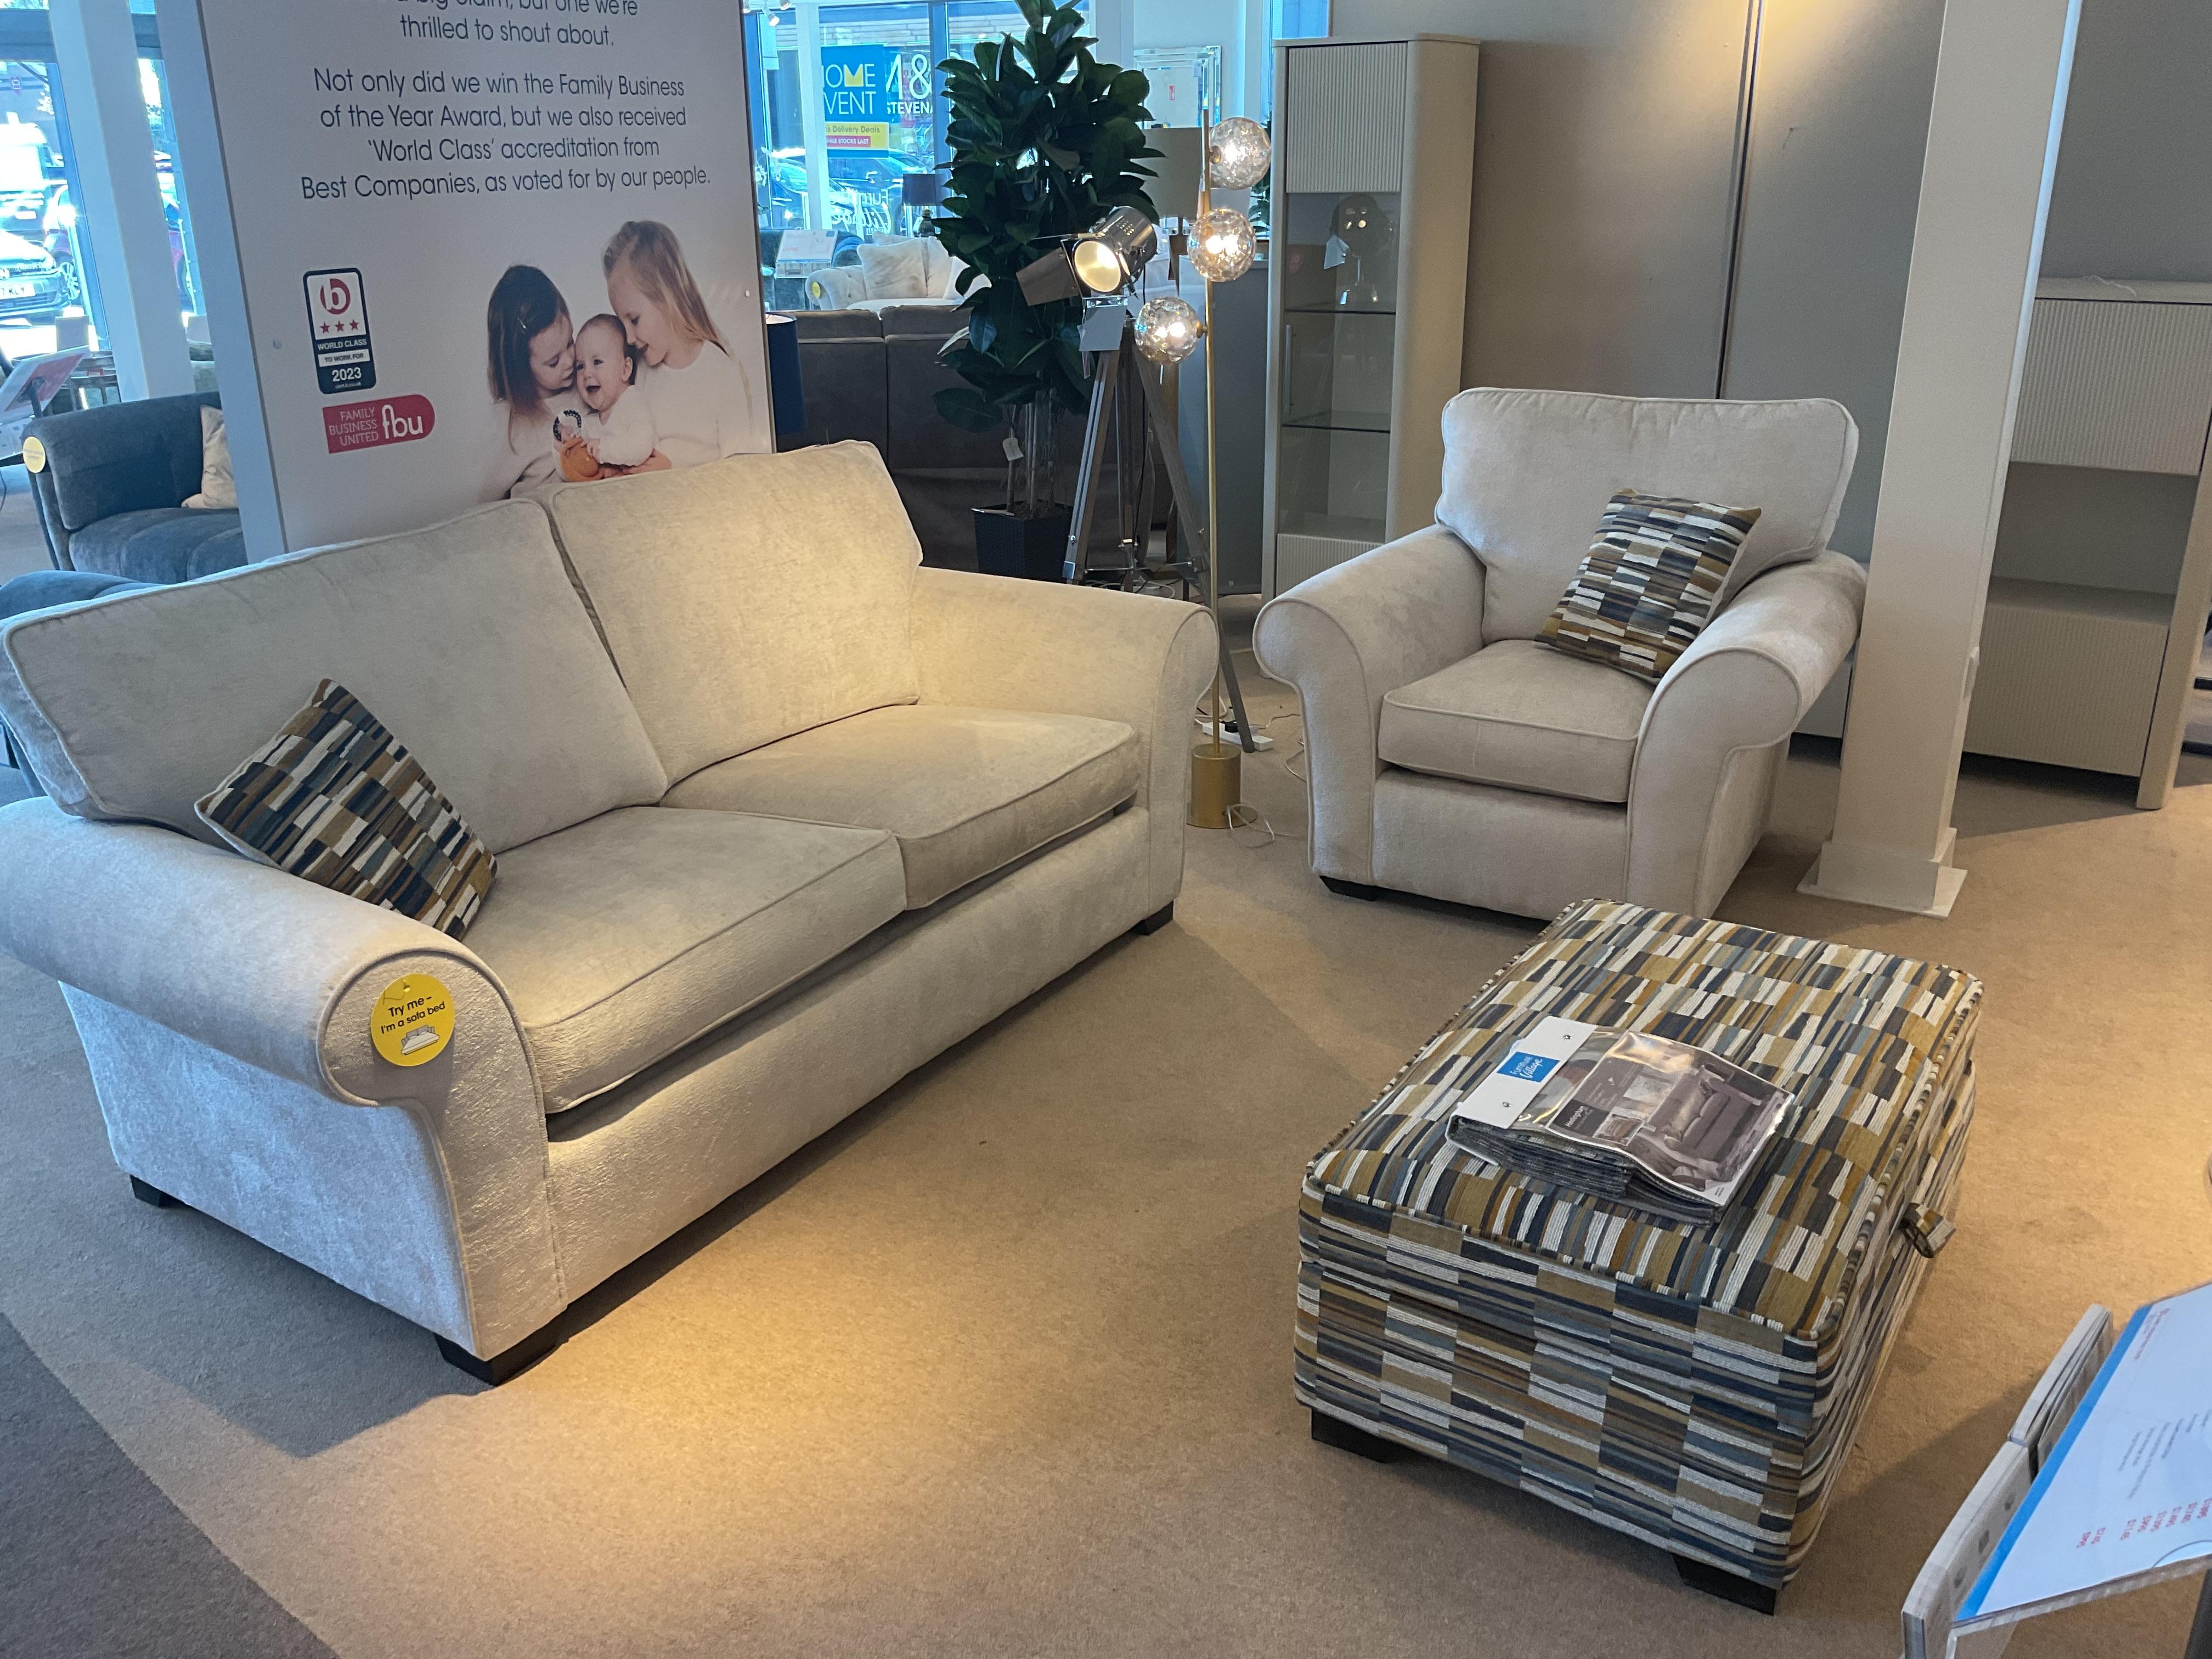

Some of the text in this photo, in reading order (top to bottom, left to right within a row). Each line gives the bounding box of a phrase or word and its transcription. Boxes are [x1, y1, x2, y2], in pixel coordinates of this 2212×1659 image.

[595, 0, 637, 15] were
[400, 15, 613, 46] thrilled to shout about.
[314, 68, 684, 99] Not only did we win the Family Business
[823, 64, 876, 88] OME
[823, 92, 876, 115] VENT
[321, 104, 686, 127] of the Year Award, but we also received
[833, 126, 859, 134] Delivery
[368, 137, 659, 161] 'World Class' accreditation from
[302, 166, 710, 200] Best Companies, as voted for by our people.
[318, 338, 367, 351] WORLD CLASS
[332, 367, 362, 382] 2023
[340, 407, 376, 421] FAMILY
[330, 419, 378, 436] BUSINESS
[340, 431, 379, 447] UNITED
[381, 1001, 445, 1034] I'm a sofa bed
[388, 1005, 404, 1017] Try
[407, 998, 425, 1011] me
